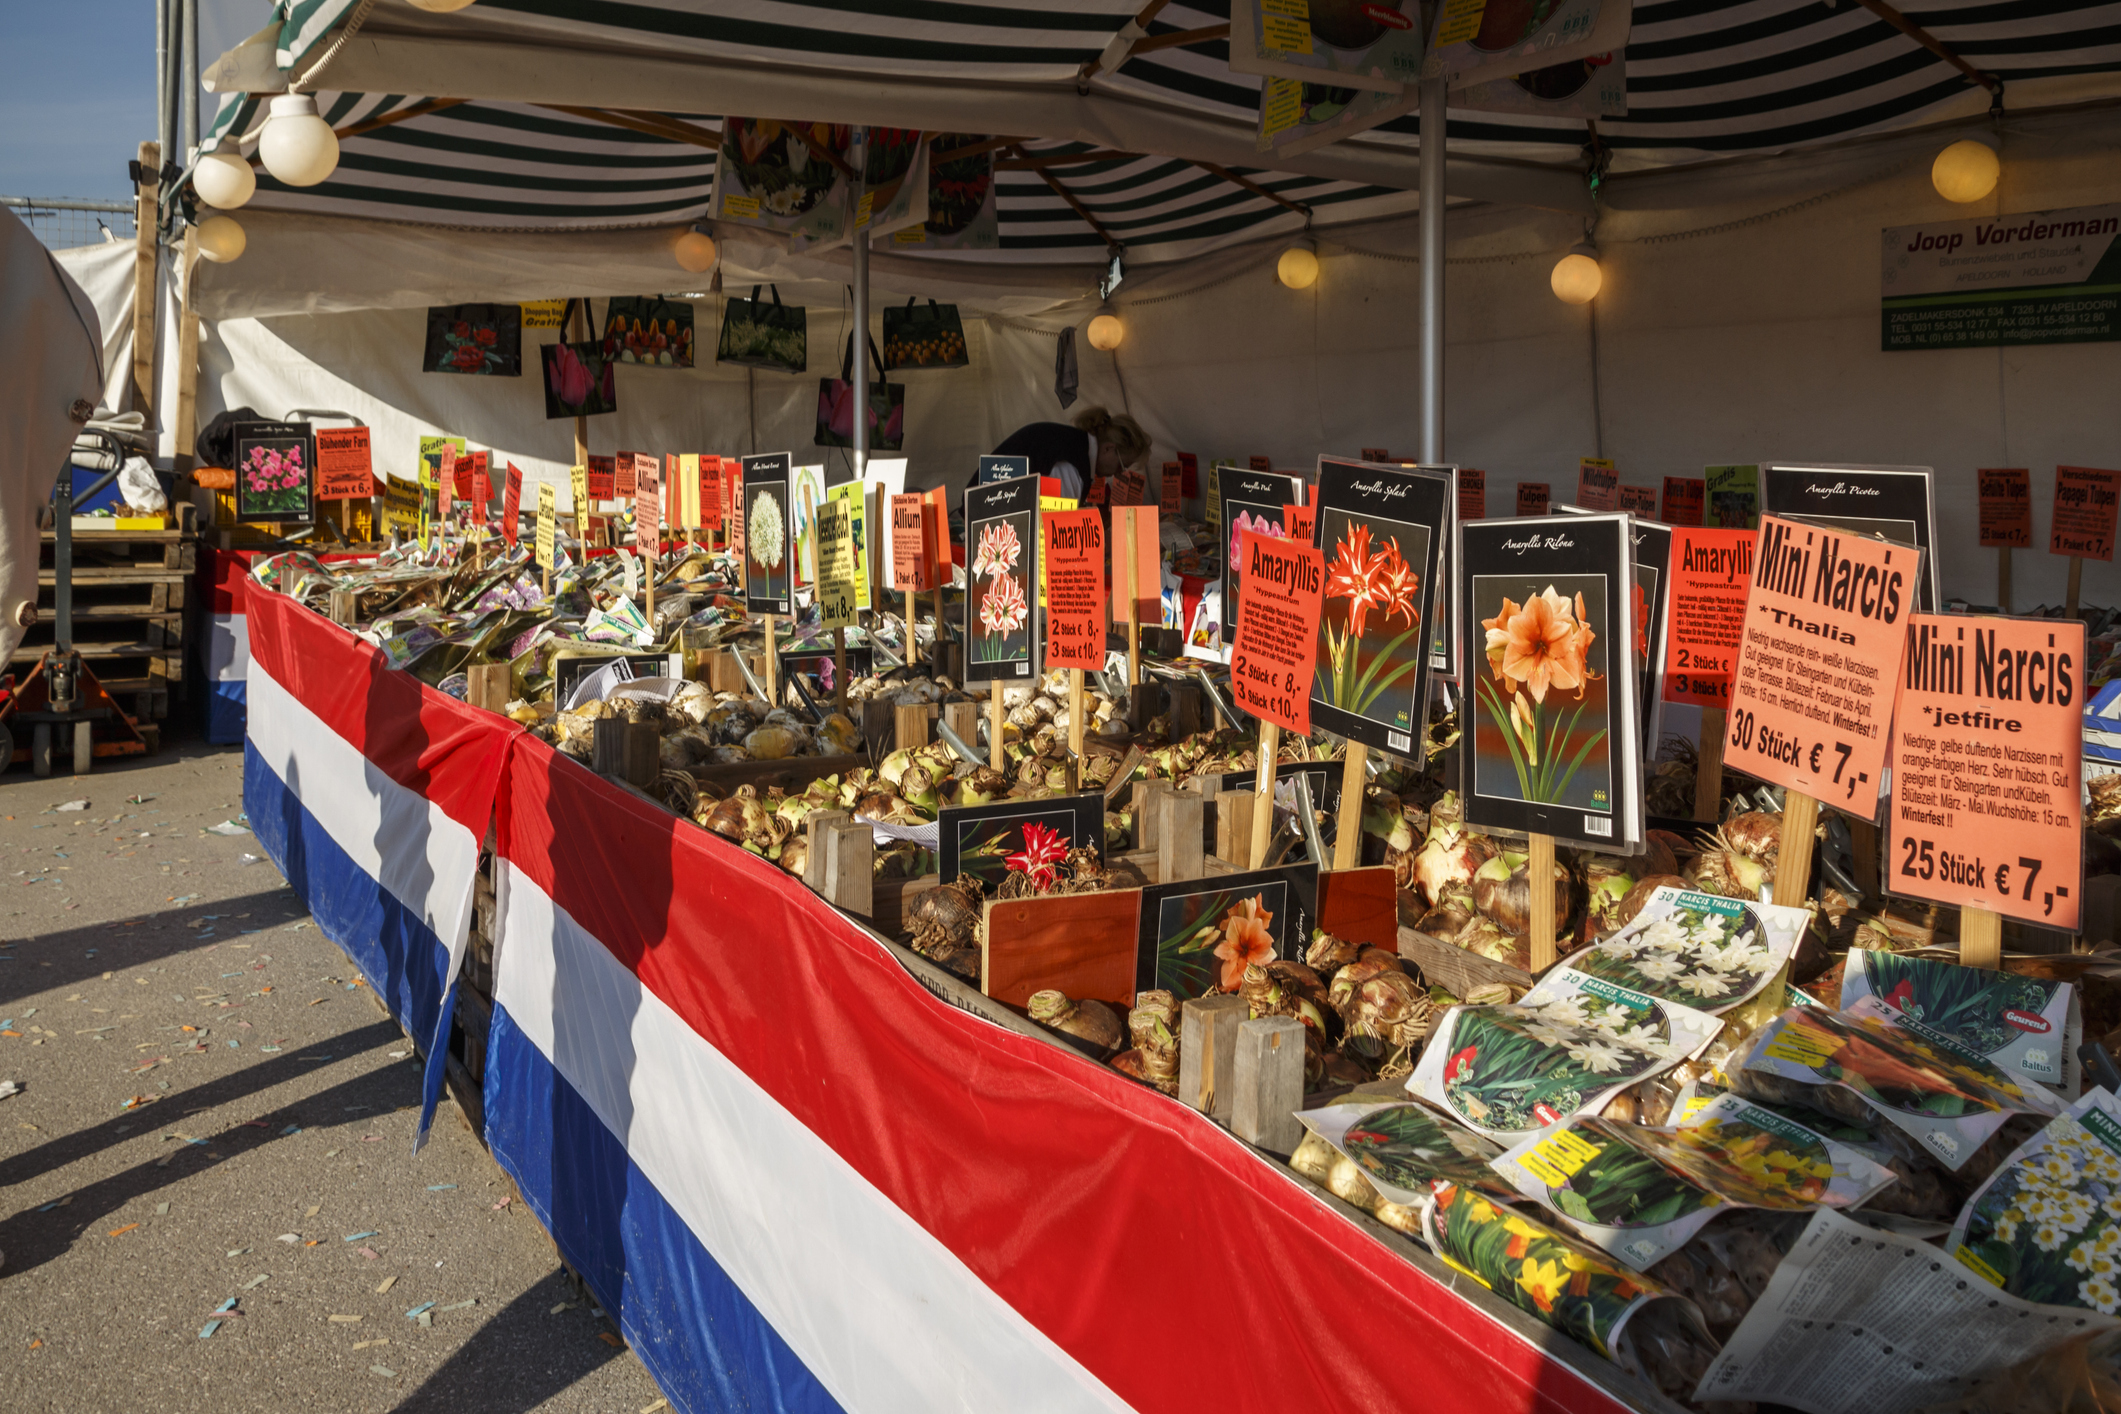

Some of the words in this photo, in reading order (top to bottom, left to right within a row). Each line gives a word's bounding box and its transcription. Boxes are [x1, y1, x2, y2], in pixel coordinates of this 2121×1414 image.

[1368, 8, 1408, 28] Meerbloemig
[1907, 232, 1962, 254] Joop
[1976, 218, 2118, 246] Vorderman
[1939, 251, 2014, 267] Blumenzwiebeln
[2018, 248, 2036, 260] und
[1956, 269, 2010, 282] APELDOORN
[2022, 266, 2066, 277] HOLLAND
[2050, 299, 2117, 314] APELDOORN
[526, 318, 562, 326] Gratis
[1912, 322, 1932, 332] 0031
[1997, 318, 2016, 328] FAX
[2018, 316, 2041, 326] 0031
[1916, 333, 1927, 344] NL
[2003, 324, 2110, 340] info@joopvorderman.nl
[354, 436, 368, 448] Farn
[638, 469, 658, 496] Allium
[1706, 466, 1736, 492] Gratis
[2062, 469, 2112, 482] Verschiedene
[322, 485, 330, 494] 3
[331, 486, 350, 494] Stück
[1350, 480, 1382, 498] Amaryllis
[1382, 485, 1412, 502] Splash
[1519, 490, 1546, 504] Tulpen
[1805, 482, 1846, 500] Amaryllis
[1848, 486, 1881, 496] Picotee
[2006, 478, 2027, 502] Tulpen
[2057, 482, 2088, 506] Papagei
[2090, 484, 2116, 509] Tulpen
[894, 508, 920, 528] Allium
[1052, 518, 1100, 556] Amaryllis
[1502, 534, 1542, 556] Amaryllis
[1544, 532, 1575, 551] Rilona
[2054, 535, 2060, 549] 1
[2064, 538, 2084, 552] Paket
[2096, 539, 2110, 558] 7,-
[1251, 542, 1320, 597] Amaryllis
[1756, 522, 1813, 600] Mini
[1813, 536, 1902, 624] Narcis
[821, 600, 826, 622] 3
[826, 604, 836, 620] Stück
[1052, 619, 1060, 635] 2
[1061, 623, 1076, 636] Stück
[1088, 620, 1098, 640] 8,-
[1052, 642, 1059, 658] 3
[1062, 646, 1076, 659] Stück
[1083, 642, 1098, 663] 10,-
[1677, 649, 1690, 668] 2
[1694, 655, 1718, 672] Stück
[1722, 660, 1728, 672] €
[1747, 628, 1770, 650] Niedrig
[1770, 634, 1806, 658] wachsende
[1806, 647, 1821, 660] rein-
[1822, 648, 1842, 668] weiße
[1844, 656, 1880, 680] Narzissen.
[1236, 656, 1246, 676] 2
[1248, 664, 1269, 686] Stück
[1271, 673, 1278, 688] €
[1285, 672, 1300, 699] 8,-
[1745, 645, 1756, 660] Gut
[1757, 650, 1784, 670] geeignet
[1786, 660, 1796, 674] für
[1796, 663, 1832, 688] Steingarten
[1834, 674, 1847, 690] und
[1848, 678, 1875, 698] Kübeln-
[1906, 624, 1964, 695] Mini
[1975, 628, 2072, 707] Narcis
[1675, 674, 1688, 693] 3
[1692, 680, 1718, 697] Stück
[1721, 682, 1728, 698] €
[1742, 665, 1757, 679] oder
[1758, 668, 1784, 689] Terrasse.
[1785, 676, 1815, 698] Blütezeit:
[1815, 687, 1843, 708] Februar
[1843, 694, 1852, 710] bis
[1854, 698, 1872, 718] April.
[1237, 681, 1246, 700] 3
[1248, 689, 1268, 710] Stück
[1278, 696, 1298, 724] 10,-
[1740, 680, 1758, 698] Höhe:
[1758, 686, 1766, 700] 15
[1767, 692, 1778, 707] cm.
[1780, 694, 1804, 715] Herrlich
[1805, 704, 1830, 724] duftend.
[1833, 712, 1870, 738] Winterfest
[1732, 708, 1754, 750] 30
[1758, 725, 1802, 768] Stück
[1809, 743, 1824, 774] €
[1833, 741, 1868, 800] 7,-
[1903, 732, 1936, 753] Niedrige
[1940, 738, 1963, 756] gelbe
[1965, 740, 2002, 760] duftende
[2004, 746, 2047, 766] Narzissen
[2050, 752, 2063, 768] mit
[1902, 752, 1966, 775] orange-farbigen
[1968, 760, 1990, 776] Herz.
[1993, 763, 2013, 780] Sehr
[2015, 766, 2049, 785] hübsch.
[2052, 771, 2068, 788] Gut
[1902, 772, 1936, 789] geeignet
[1941, 774, 1952, 790] für
[1954, 777, 2001, 798] Steingarten
[1901, 806, 1945, 827] Winterfest
[1902, 787, 1938, 807] Blütezeit:
[1941, 794, 1961, 810] März
[2043, 810, 2053, 825] 15
[2055, 815, 2072, 828] cm.
[1901, 836, 1934, 880] 25
[1940, 850, 1985, 889] Stück
[1994, 864, 2010, 895] €
[2018, 856, 2068, 917] 7,-
[1658, 891, 1674, 902] 30
[1680, 893, 1710, 906] NARCIS
[1712, 899, 1741, 911] THALIA
[1562, 972, 1580, 984] 30
[1586, 980, 1618, 996] NARCIS
[1619, 991, 1650, 1006] THALIA
[1871, 1001, 1892, 1015] 25
[1900, 1016, 1941, 1040] NARCIS
[1940, 1039, 1986, 1064] JETFIRE
[2006, 1011, 2047, 1030] Geurend
[2022, 1060, 2052, 1072] Baltus
[1719, 1099, 1740, 1111] 25
[1744, 1108, 1779, 1127] NARCIS
[1775, 1122, 1816, 1143] JETFIRE
[1926, 1134, 1956, 1159] Baltus
[1624, 1244, 1648, 1262] Baltus
